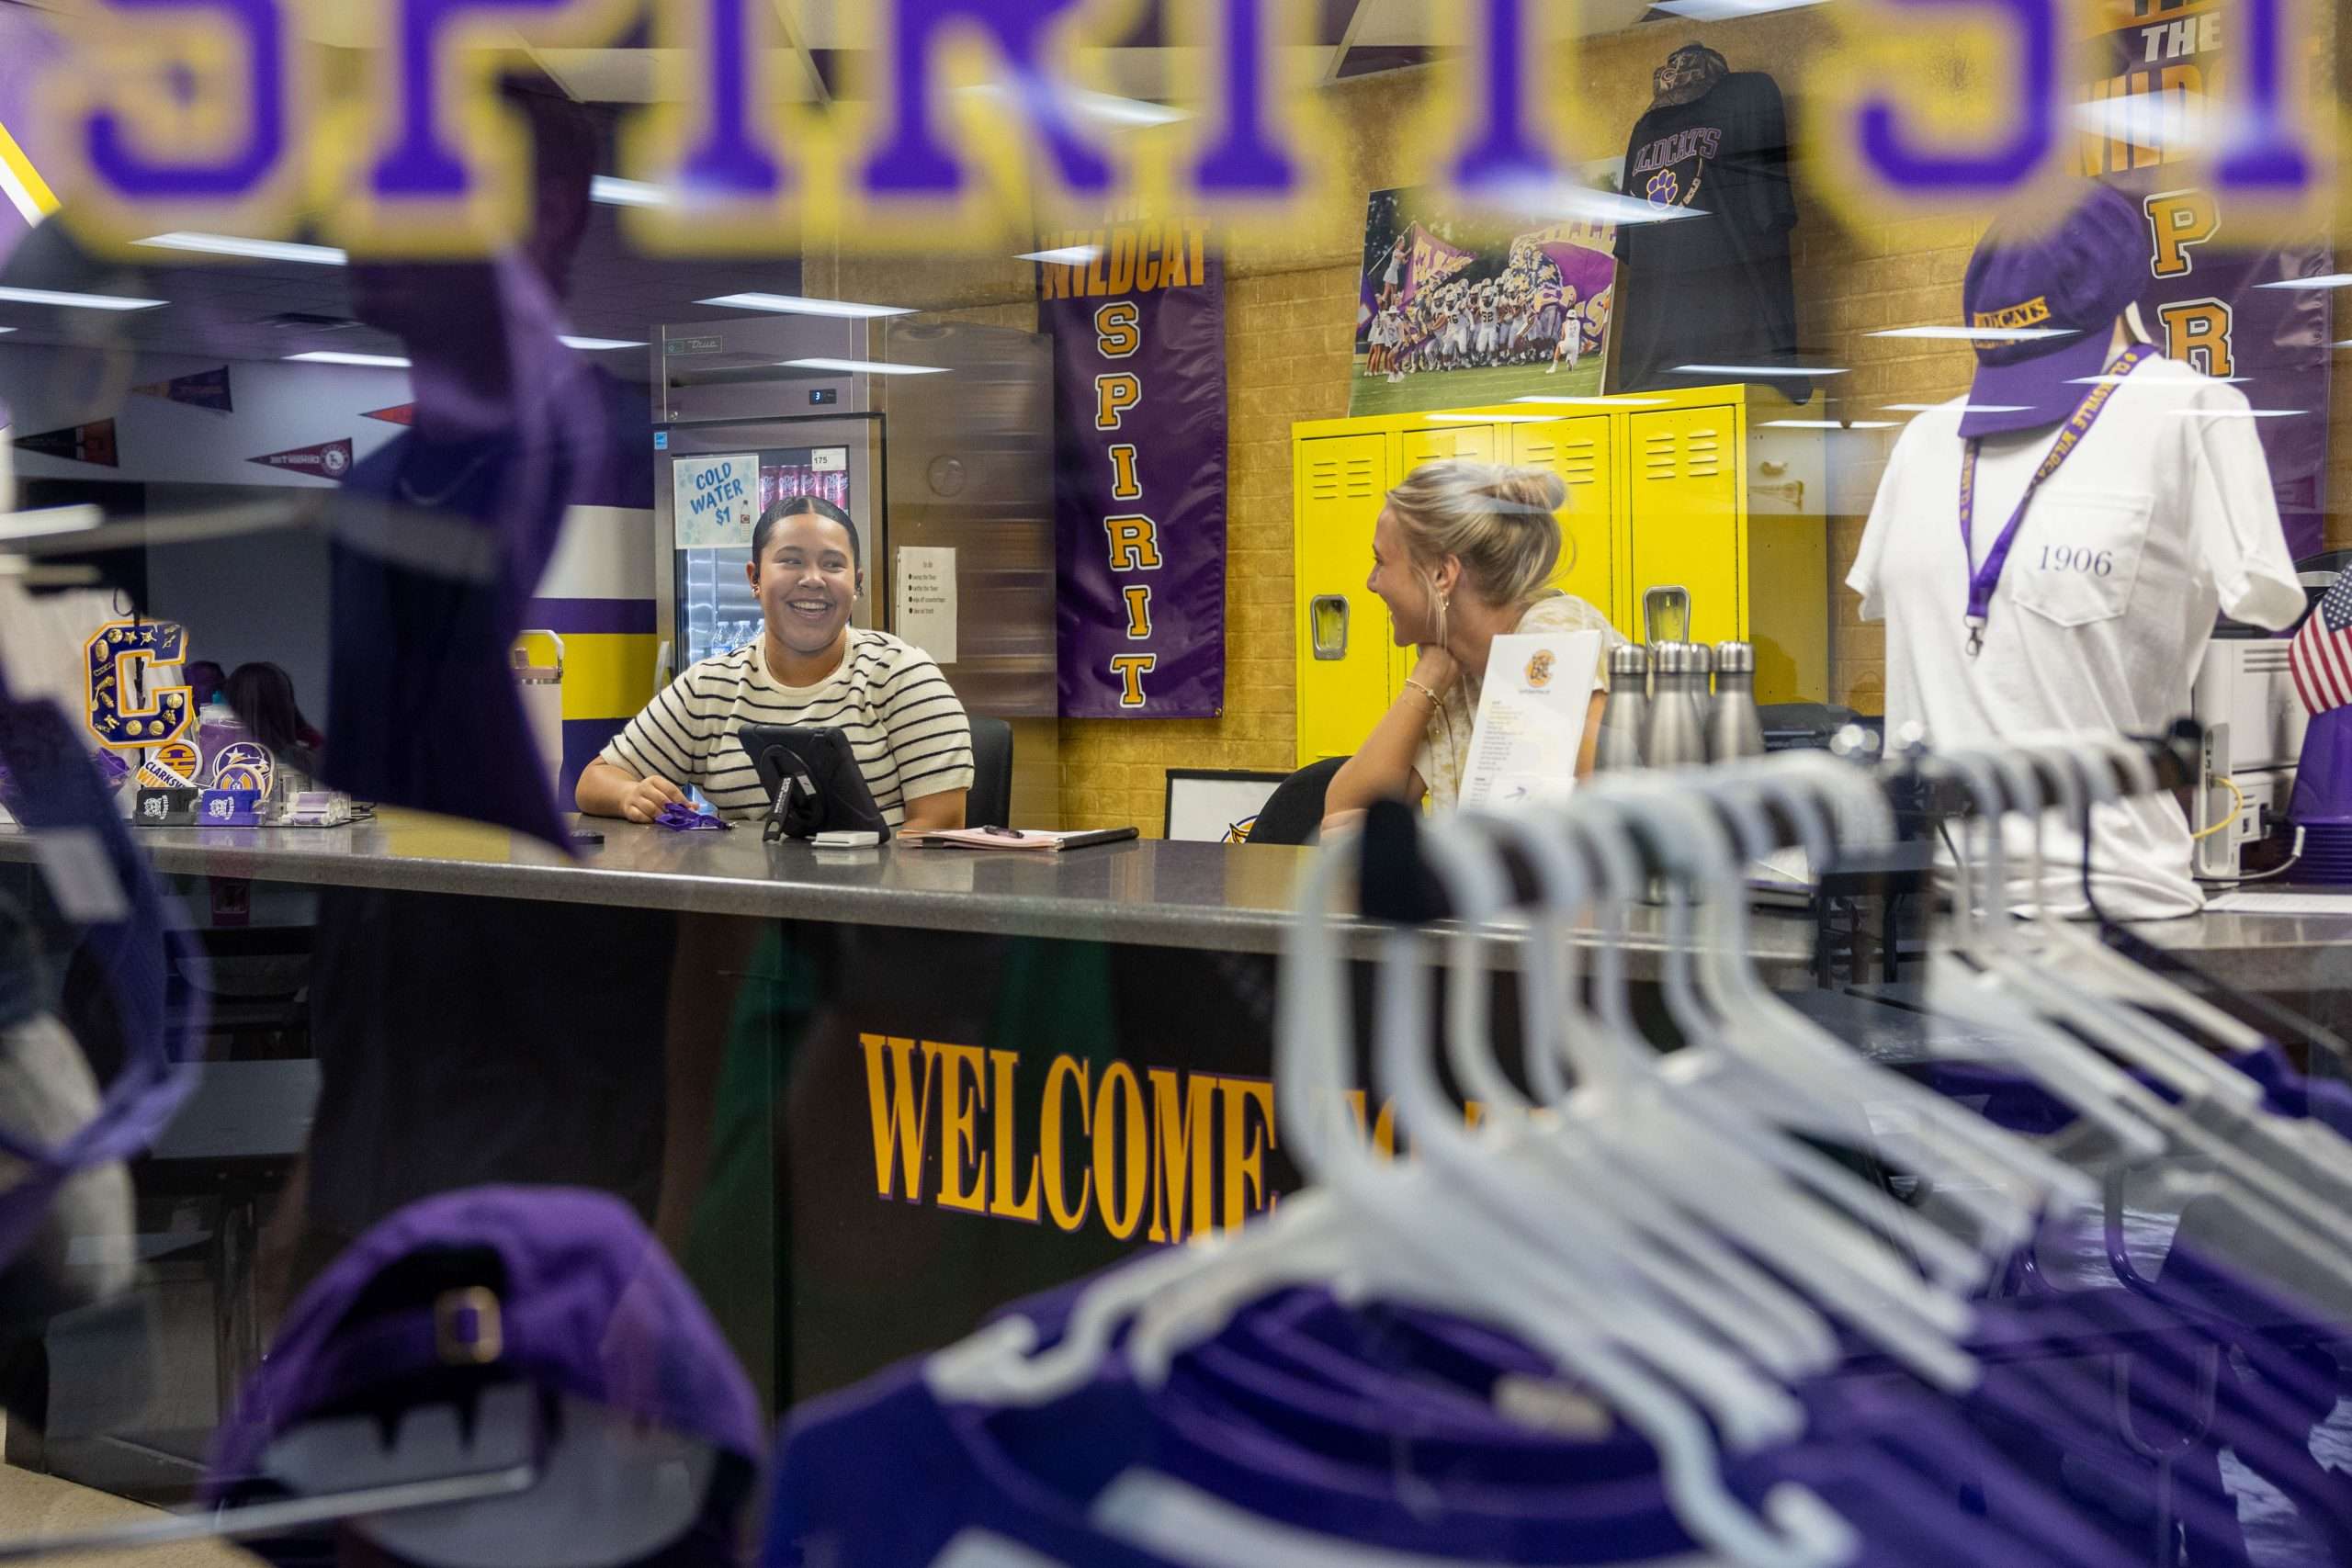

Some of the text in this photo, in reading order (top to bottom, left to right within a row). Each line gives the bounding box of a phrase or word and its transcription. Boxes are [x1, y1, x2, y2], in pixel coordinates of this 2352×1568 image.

[2141, 11, 2222, 63] THE
[1041, 218, 1212, 301] WILDCAT
[695, 462, 732, 491] COLD
[690, 478, 743, 514] WATER
[716, 506, 731, 525] $1
[2041, 545, 2112, 578] 1906
[84, 619, 192, 749] C
[145, 761, 187, 789] CLARKSV
[859, 1032, 1278, 1247] WELCOME
